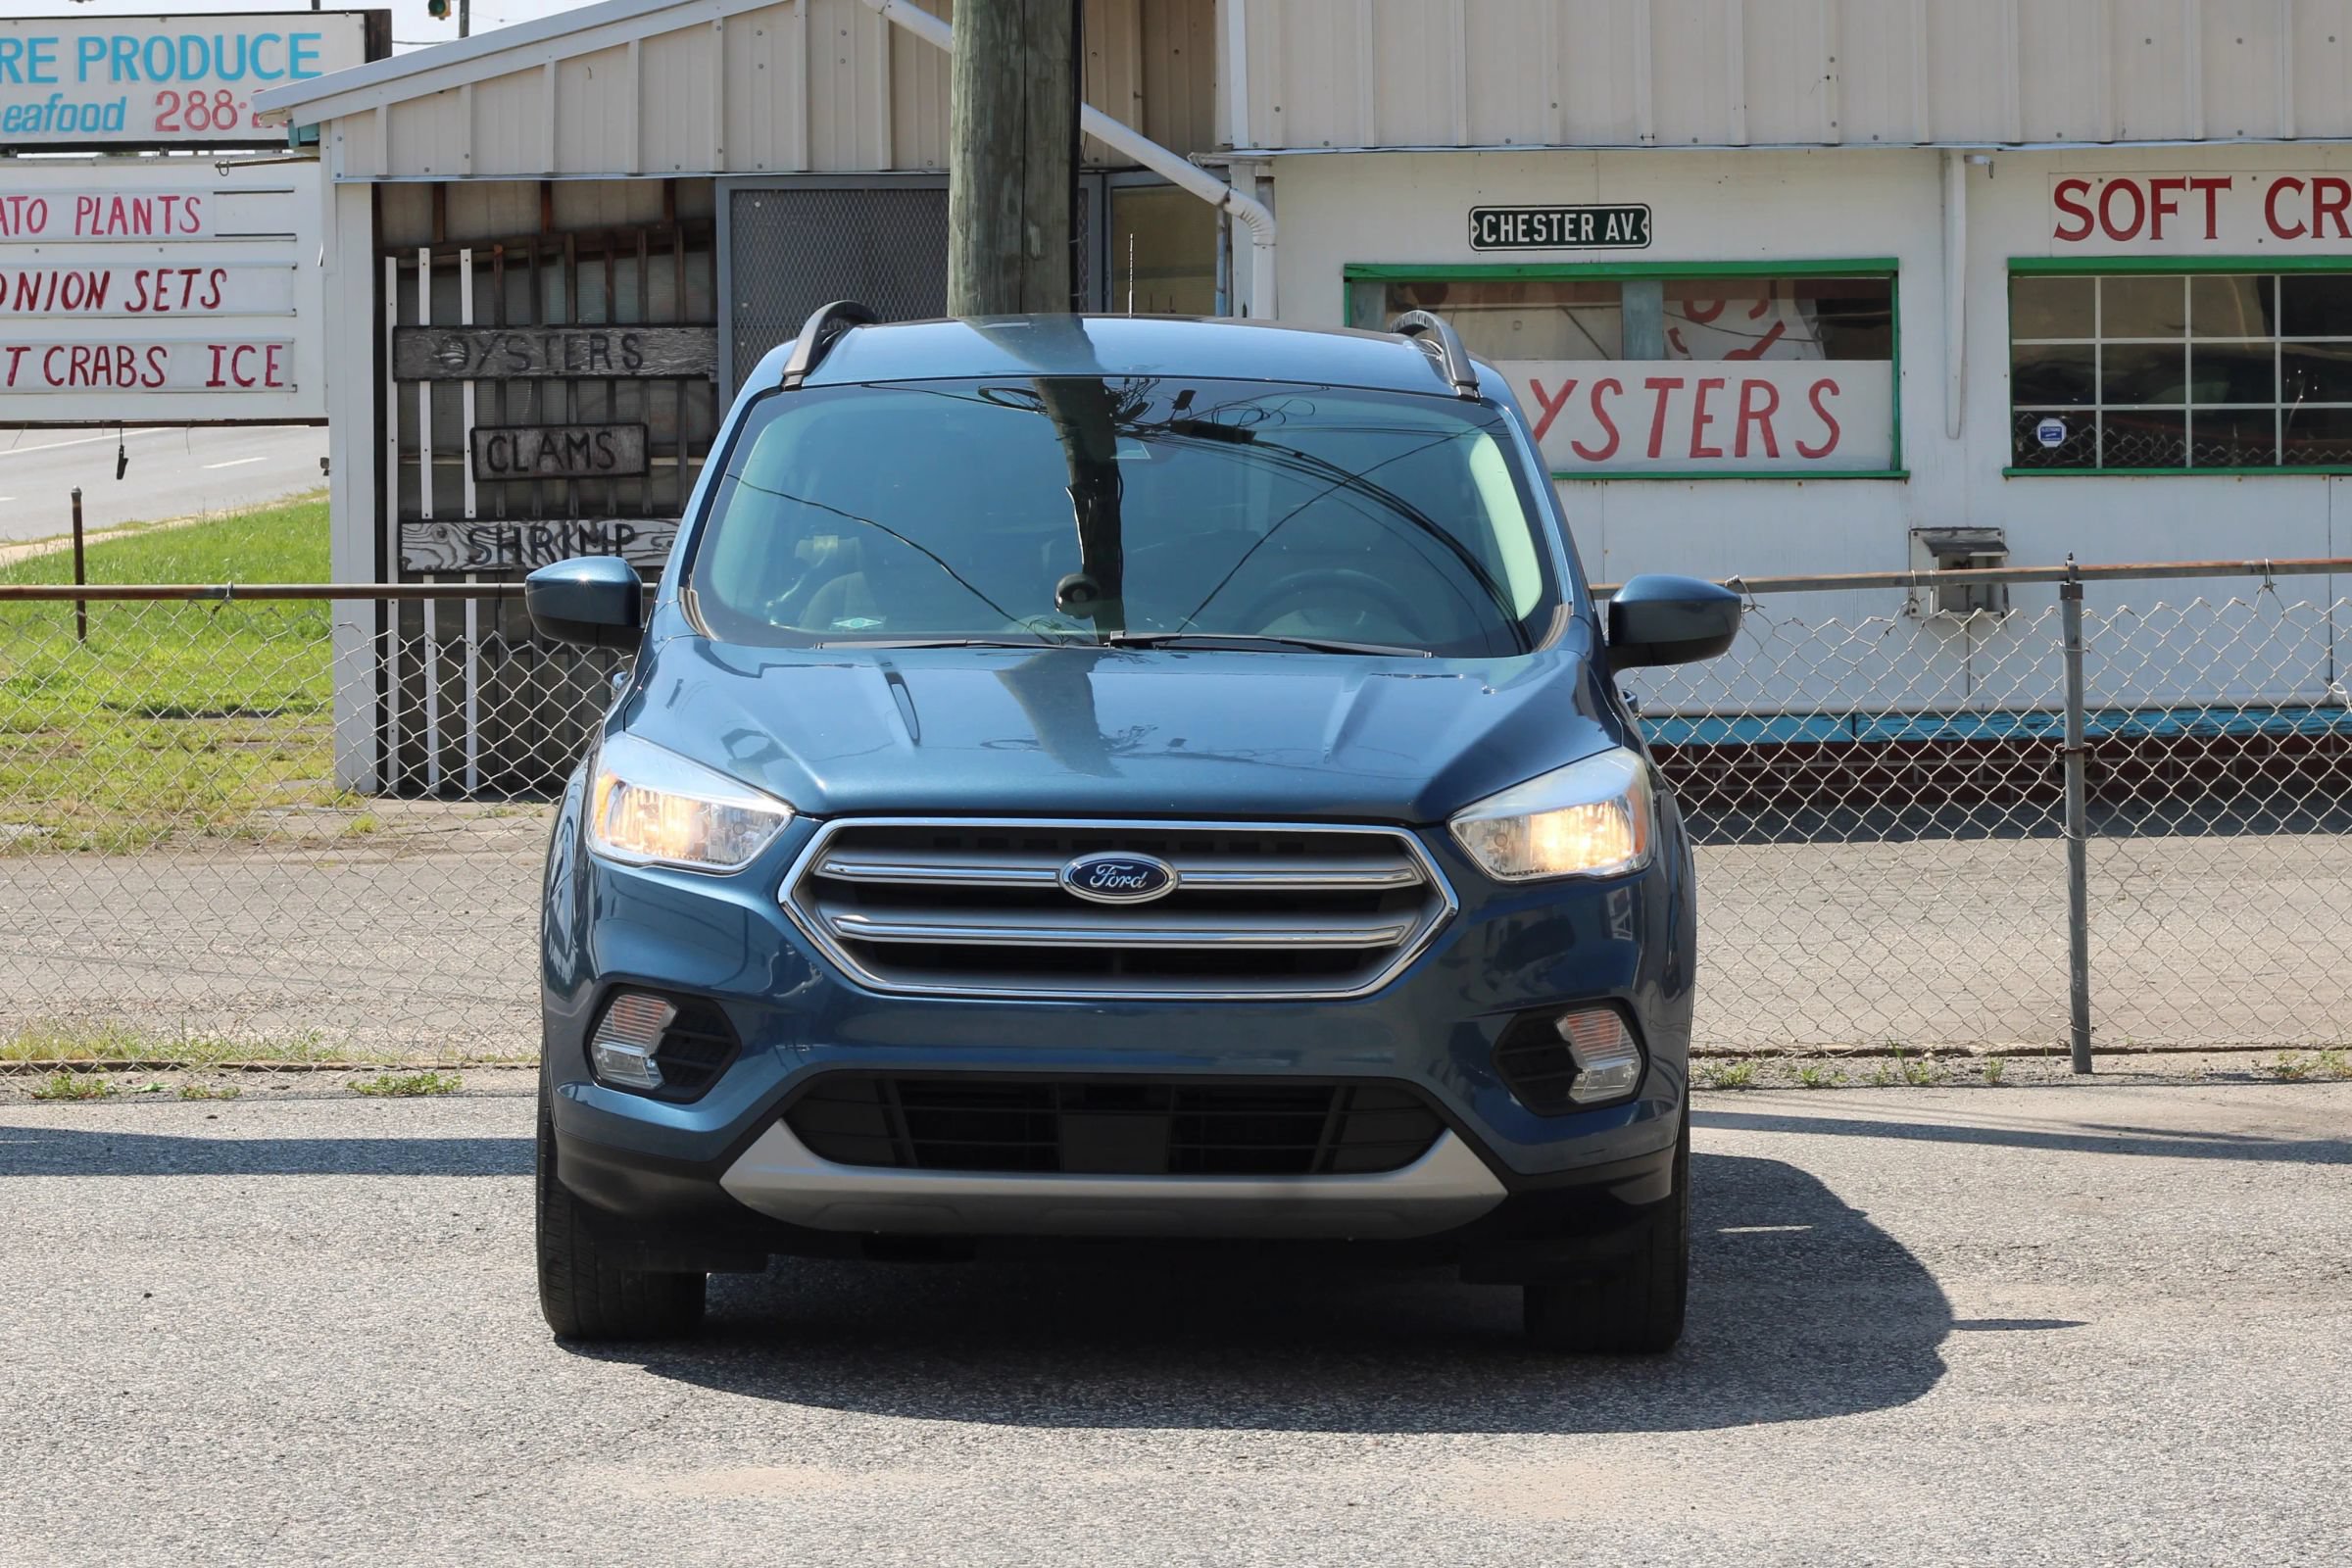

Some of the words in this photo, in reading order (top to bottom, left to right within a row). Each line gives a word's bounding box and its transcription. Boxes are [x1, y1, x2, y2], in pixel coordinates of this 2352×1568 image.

[78, 31, 322, 82] PRODUCE
[0, 93, 126, 132] eafood
[74, 196, 202, 236] PLANTS
[1482, 213, 1594, 243] CHESTER
[1604, 212, 1639, 241] AV.
[2053, 175, 2232, 242] SOFT
[2264, 176, 2352, 240] CR
[124, 269, 227, 313] SETS
[43, 345, 168, 388] CRABS
[206, 345, 283, 387] ICE
[438, 332, 644, 372] OYSTERS
[486, 431, 617, 472] CLAMS
[466, 524, 637, 565] SHRIMP
[1089, 863, 1149, 889] Ford
